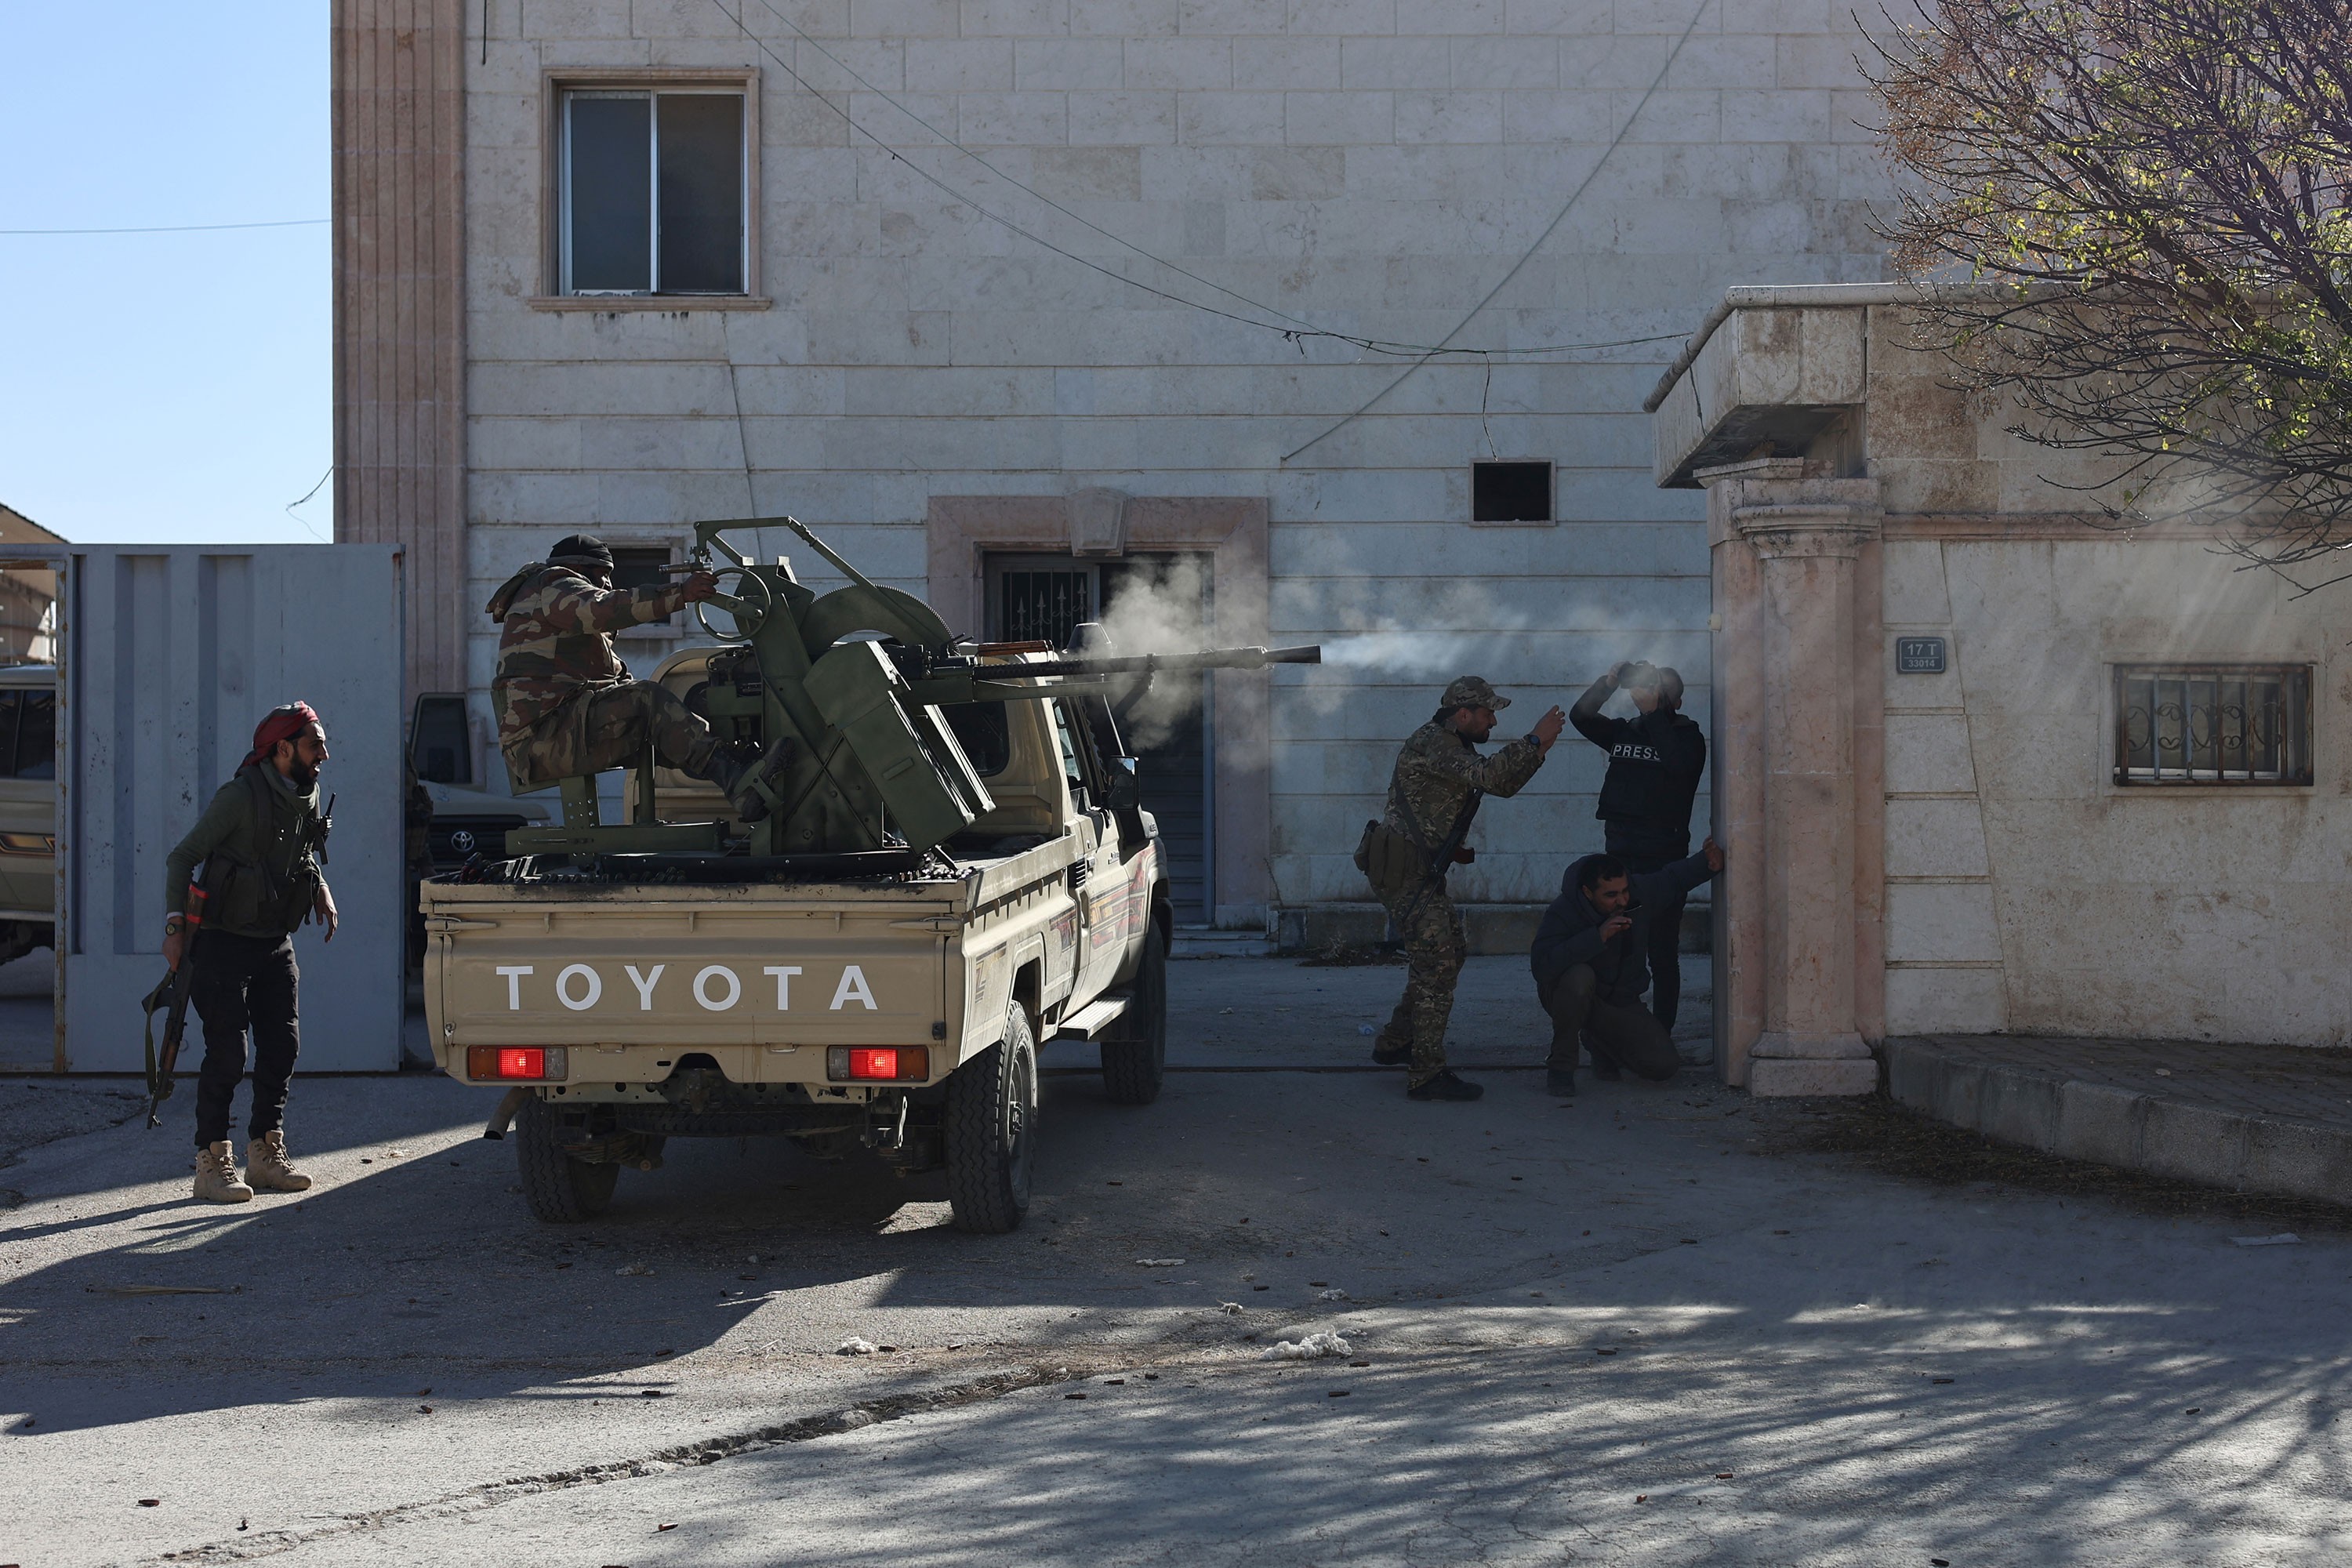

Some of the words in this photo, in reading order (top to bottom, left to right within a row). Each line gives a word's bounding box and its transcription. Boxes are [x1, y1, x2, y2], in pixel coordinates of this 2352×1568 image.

[1907, 644, 1923, 655] 17
[1927, 644, 1937, 655] T
[1907, 659, 1936, 668] 33014
[495, 963, 878, 1011] TOYOTA
